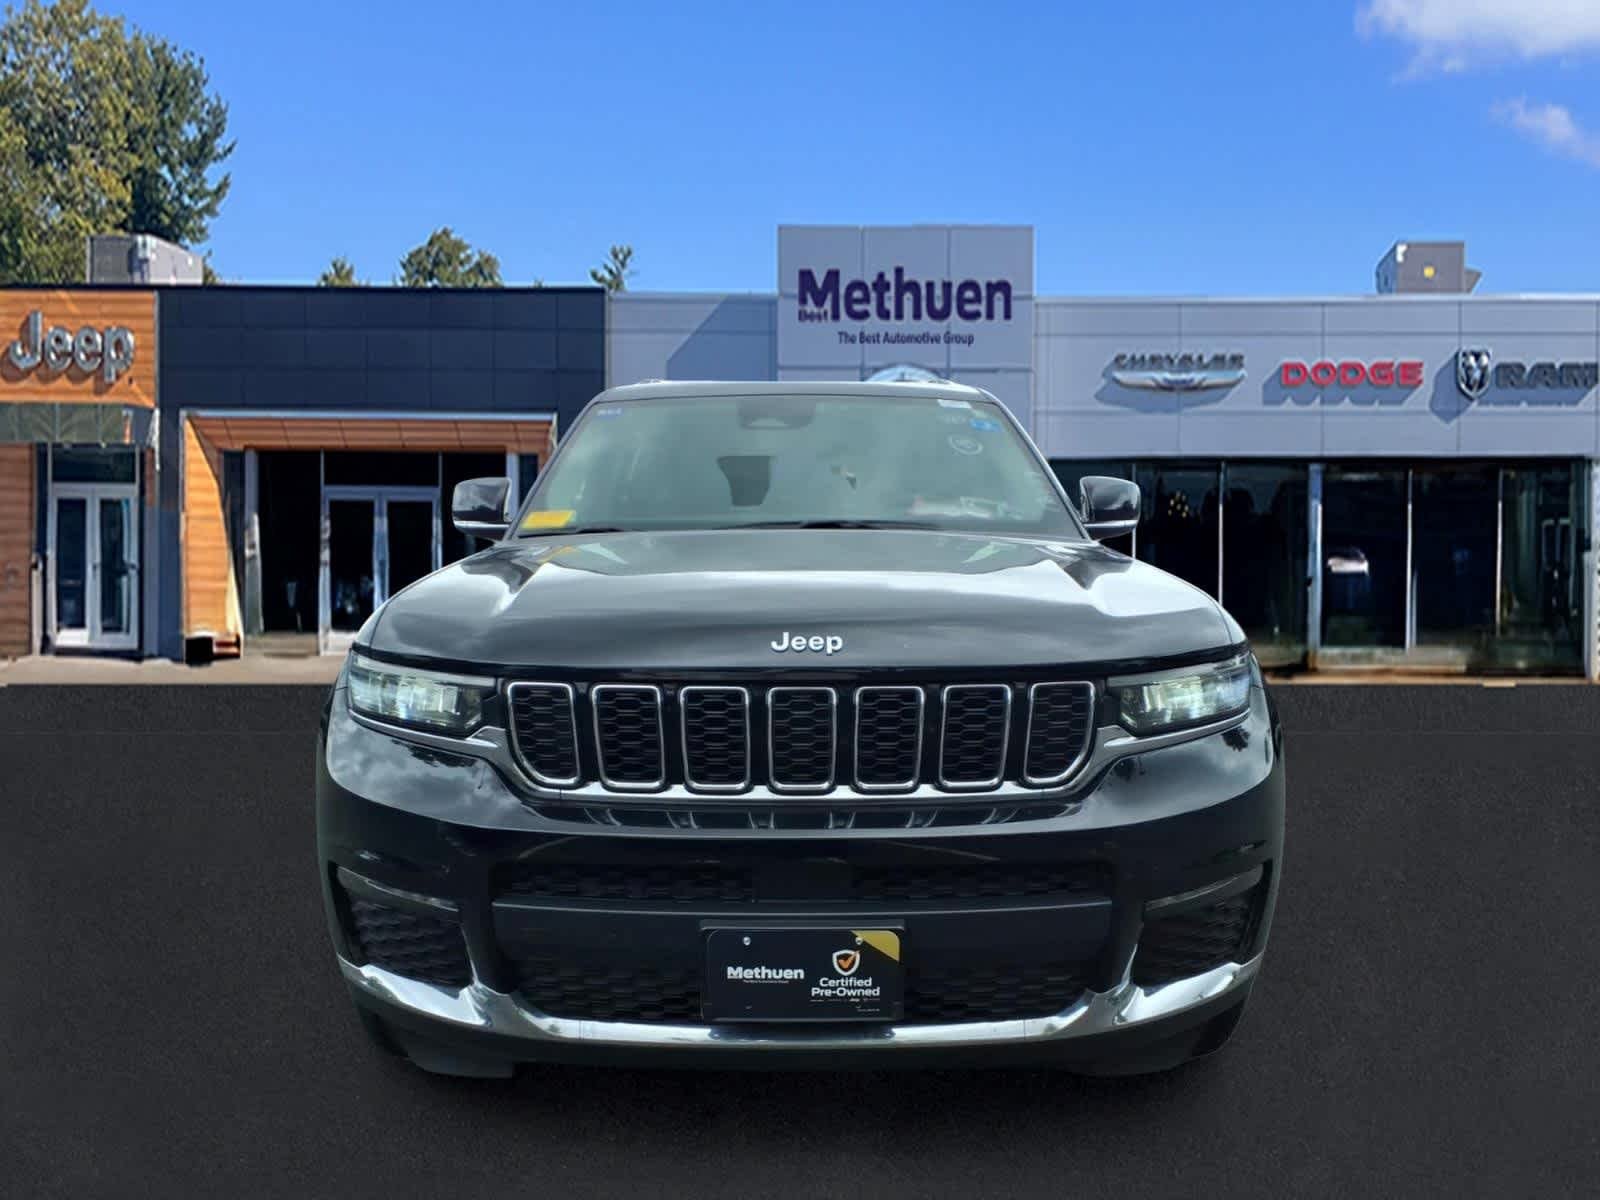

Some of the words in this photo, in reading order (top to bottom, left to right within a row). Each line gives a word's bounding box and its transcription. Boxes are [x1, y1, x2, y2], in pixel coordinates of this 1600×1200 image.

[798, 266, 1012, 321] Methuen
[9, 310, 134, 383] Jeep
[837, 331, 858, 345] The
[859, 331, 881, 345] Best
[882, 331, 941, 345] Automotive
[942, 331, 975, 347] Group
[1114, 353, 1245, 370] CHRYSLER
[1280, 361, 1423, 387] DODGE
[1495, 362, 1599, 389] RAM
[770, 631, 844, 656] Jeep
[727, 966, 805, 980] Methuen
[819, 977, 873, 987] Certified
[811, 987, 881, 998] Pre-Owned
